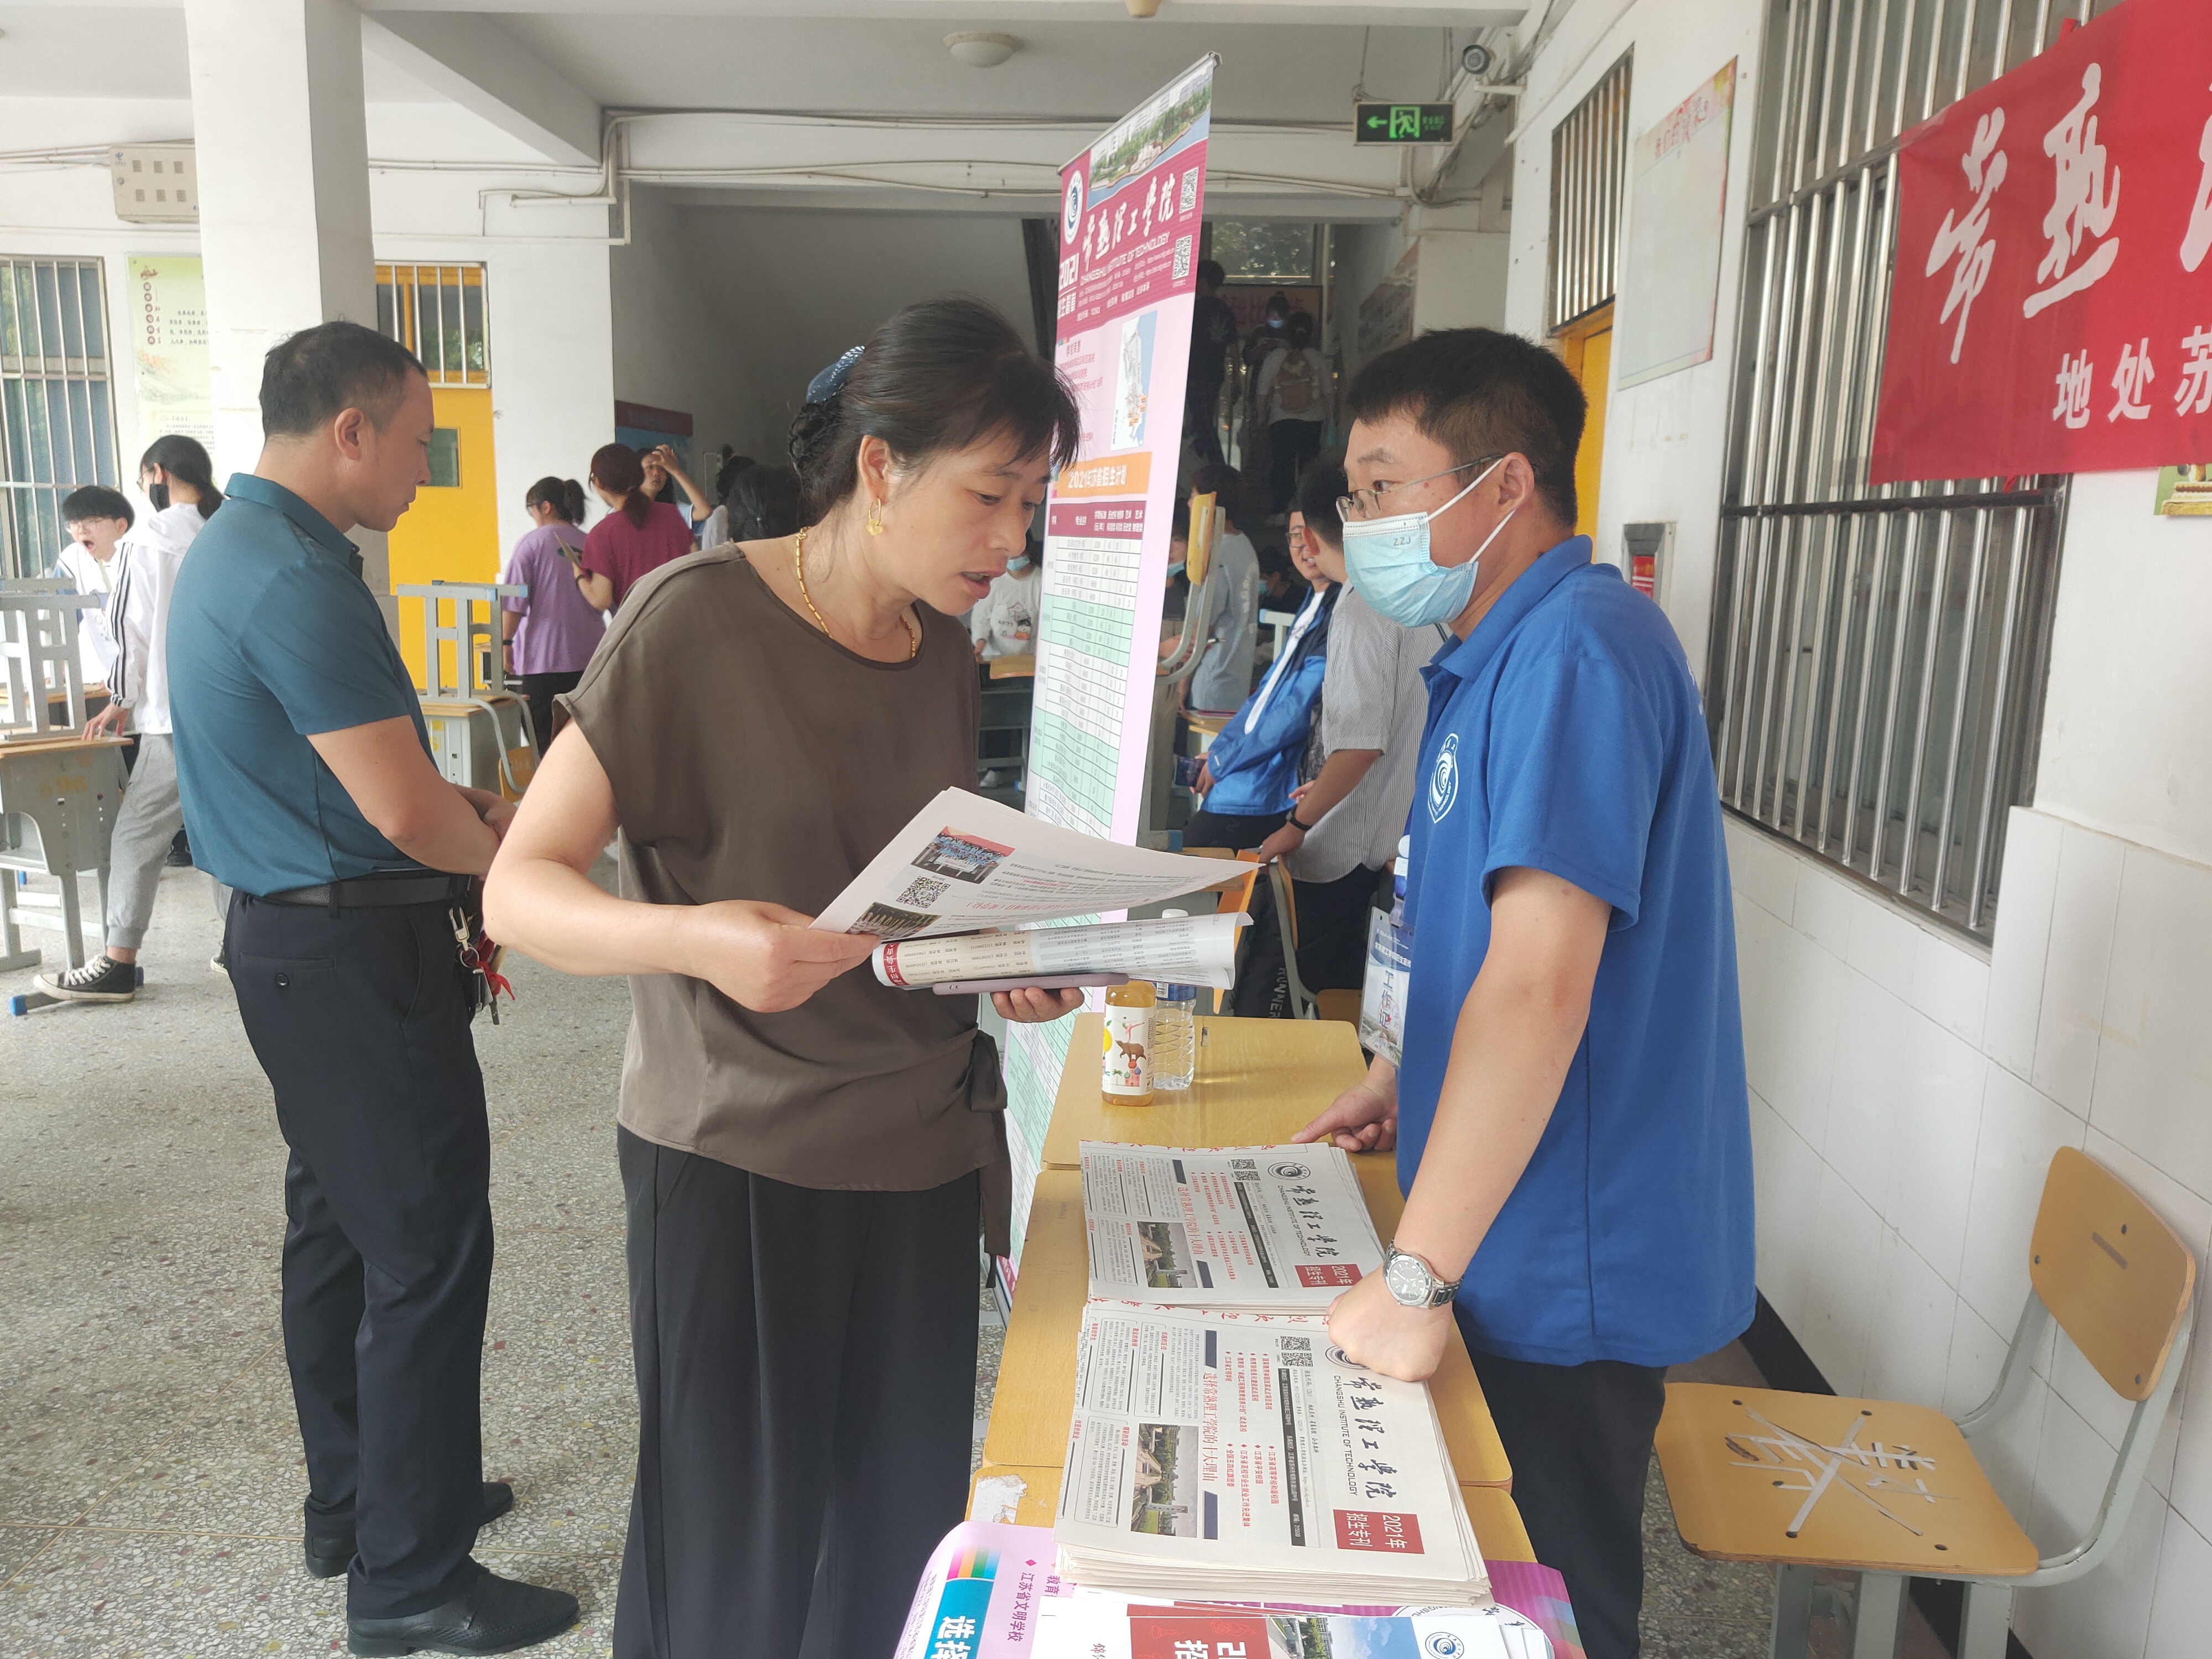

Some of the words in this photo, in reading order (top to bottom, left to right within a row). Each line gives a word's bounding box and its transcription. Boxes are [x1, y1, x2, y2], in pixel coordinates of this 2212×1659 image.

[1177, 1186, 1204, 1255] 选择常熟理工学院的十大理由
[1285, 1206, 1297, 1224] INSTITUTE
[1296, 1230, 1311, 1256] TECHNOLOGY
[1305, 1266, 1328, 1285] 招生专刊
[1331, 1265, 1353, 1285] 2021年
[1333, 1375, 1347, 1408] CHANGSHU
[1202, 1372, 1218, 1482] 选择常熟理工学院的十大理由
[1338, 1409, 1350, 1438] INSTITUTE
[1343, 1439, 1352, 1448] OF
[1226, 1449, 1235, 1488] 全国五四红旗团委
[1254, 1451, 1264, 1484] 江苏省平安校园
[1268, 1451, 1279, 1505] 江苏省高等学校和谐校园
[1345, 1449, 1359, 1496] TECHNOLOGY
[1240, 1450, 1251, 1527] 江苏省高校毕业生就业工作先进集体
[1346, 1512, 1373, 1547] 招生专刊
[1383, 1514, 1408, 1549] 2021年
[1044, 1575, 1061, 1598] 教育
[1007, 1572, 1035, 1642] 江苏省文明学校
